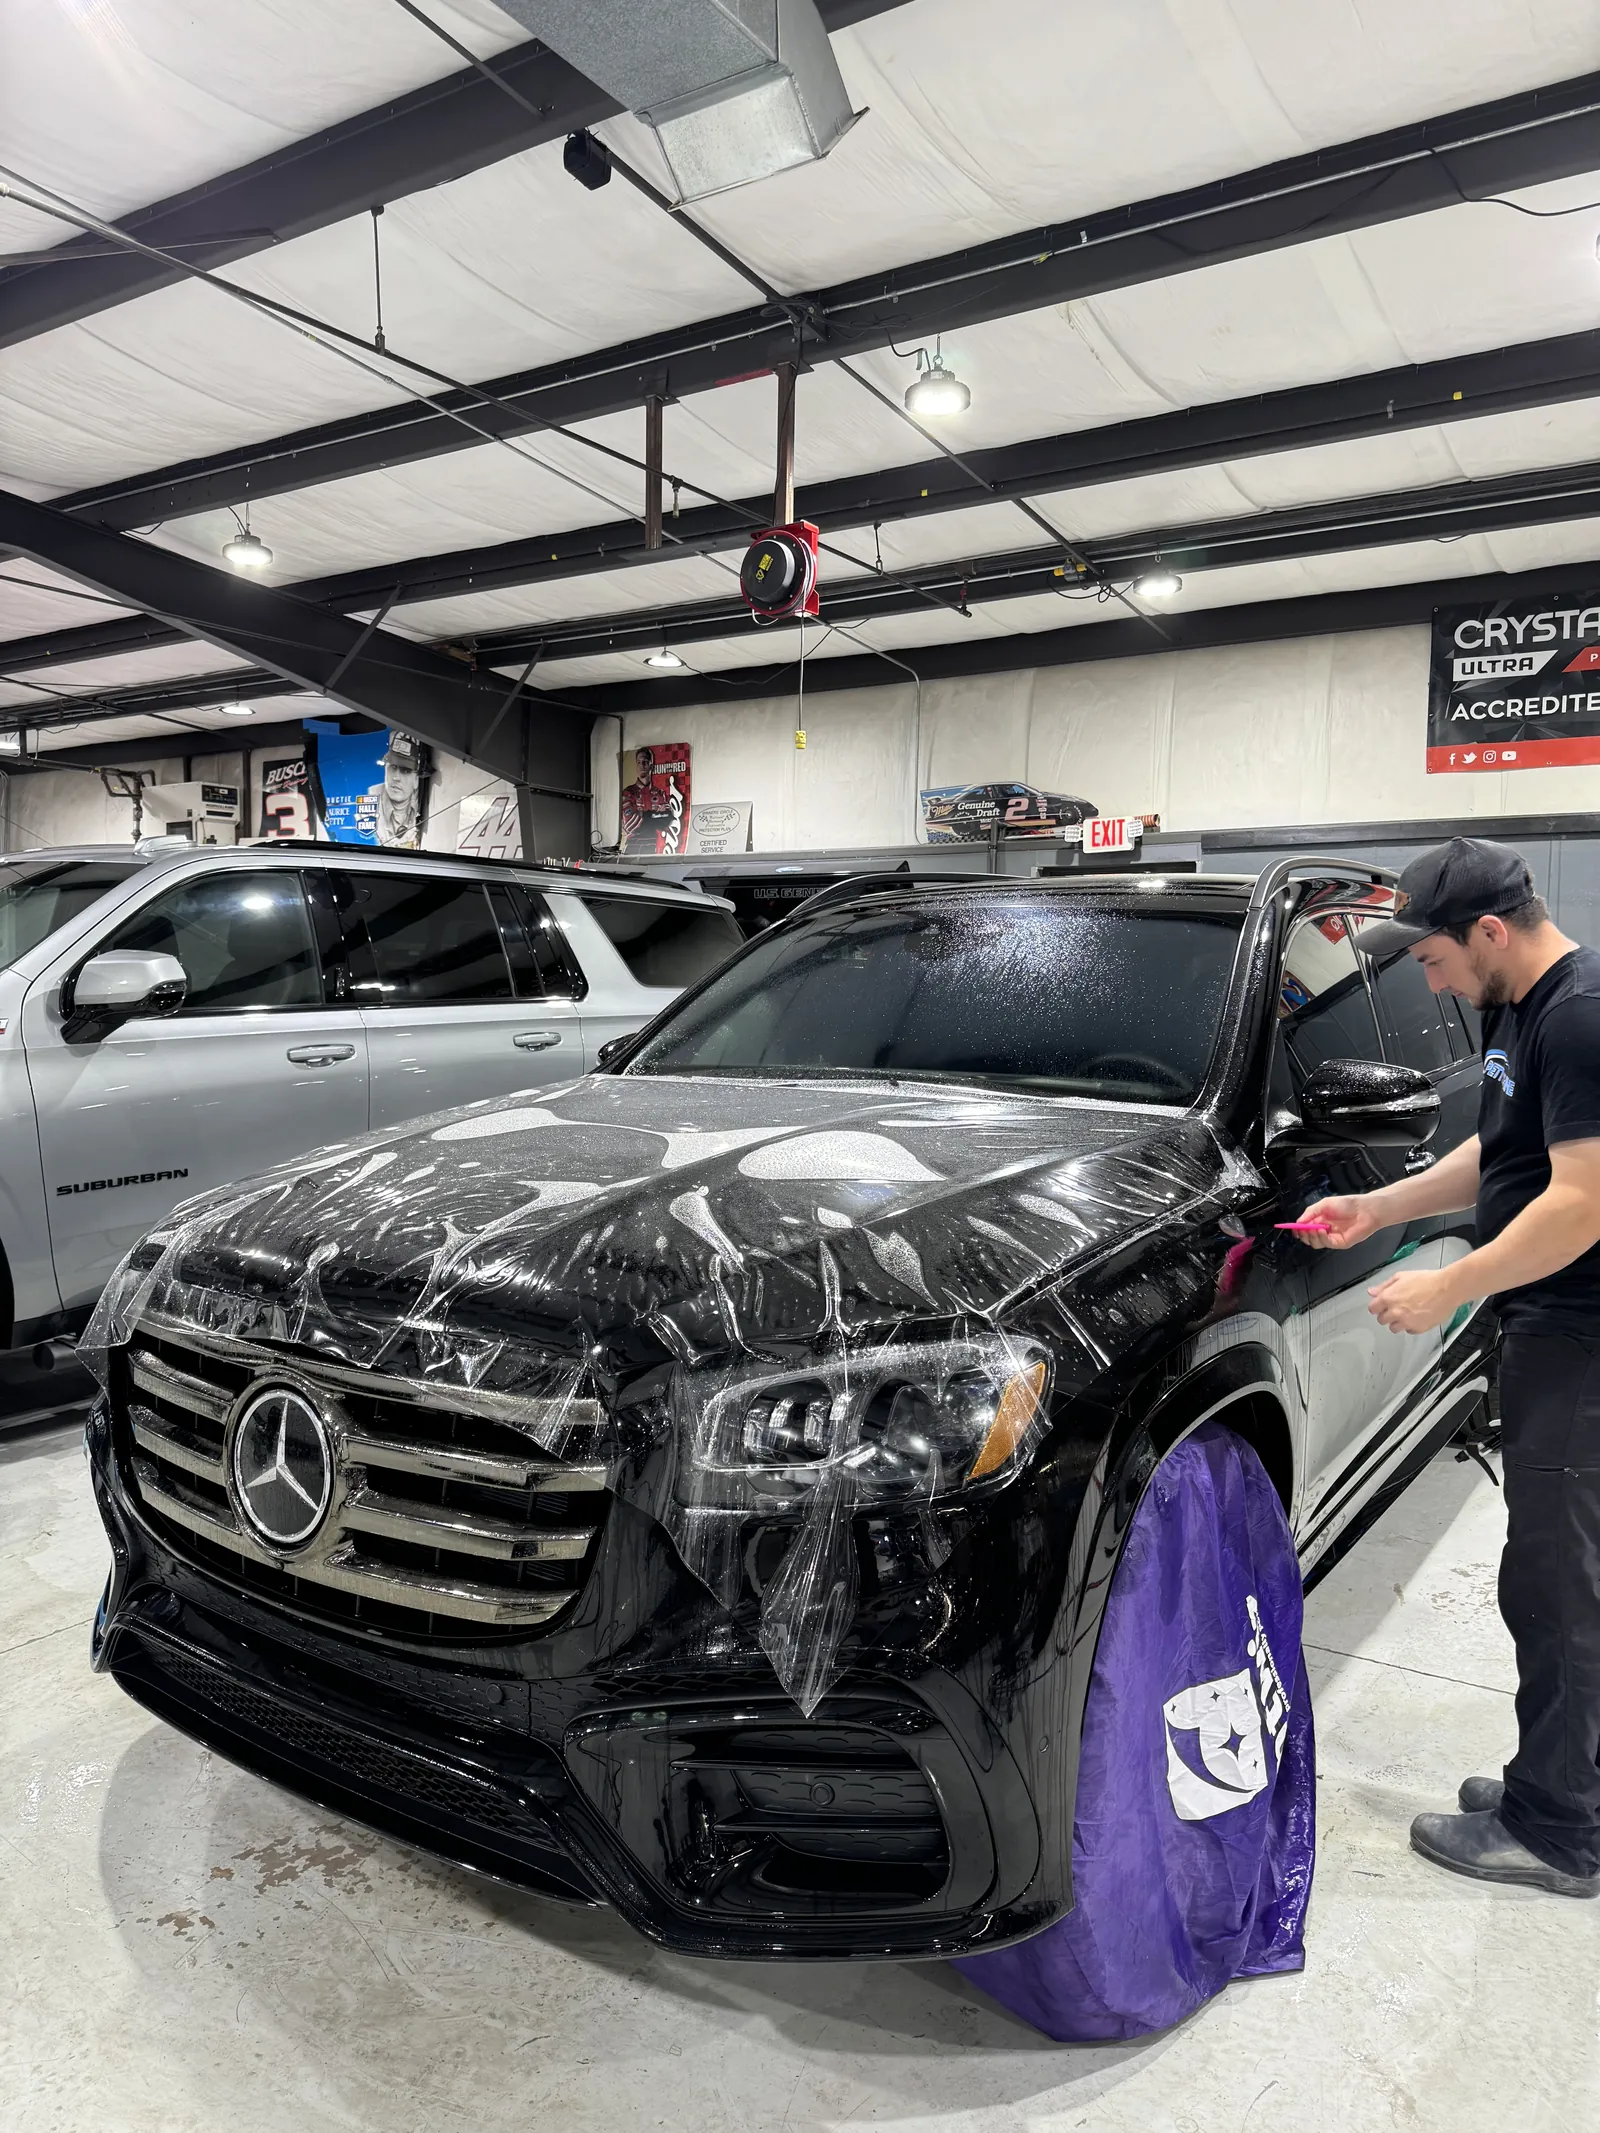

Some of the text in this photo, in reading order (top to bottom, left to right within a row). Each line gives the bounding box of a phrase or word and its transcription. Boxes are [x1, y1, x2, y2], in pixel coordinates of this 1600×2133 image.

[1460, 656, 1534, 676] ULTRA
[1450, 692, 1600, 721] ACCREDITE
[266, 761, 307, 785] BUSC
[265, 793, 310, 838] 3
[358, 804, 377, 814] HALL
[957, 800, 996, 810] Genuine
[976, 807, 1001, 817] Draft
[1004, 797, 1030, 820] 2
[357, 821, 377, 830] FAME
[1091, 818, 1126, 848] EXIT
[699, 839, 728, 847] CERTIFIED
[56, 1168, 189, 1196] SUBURBAN
